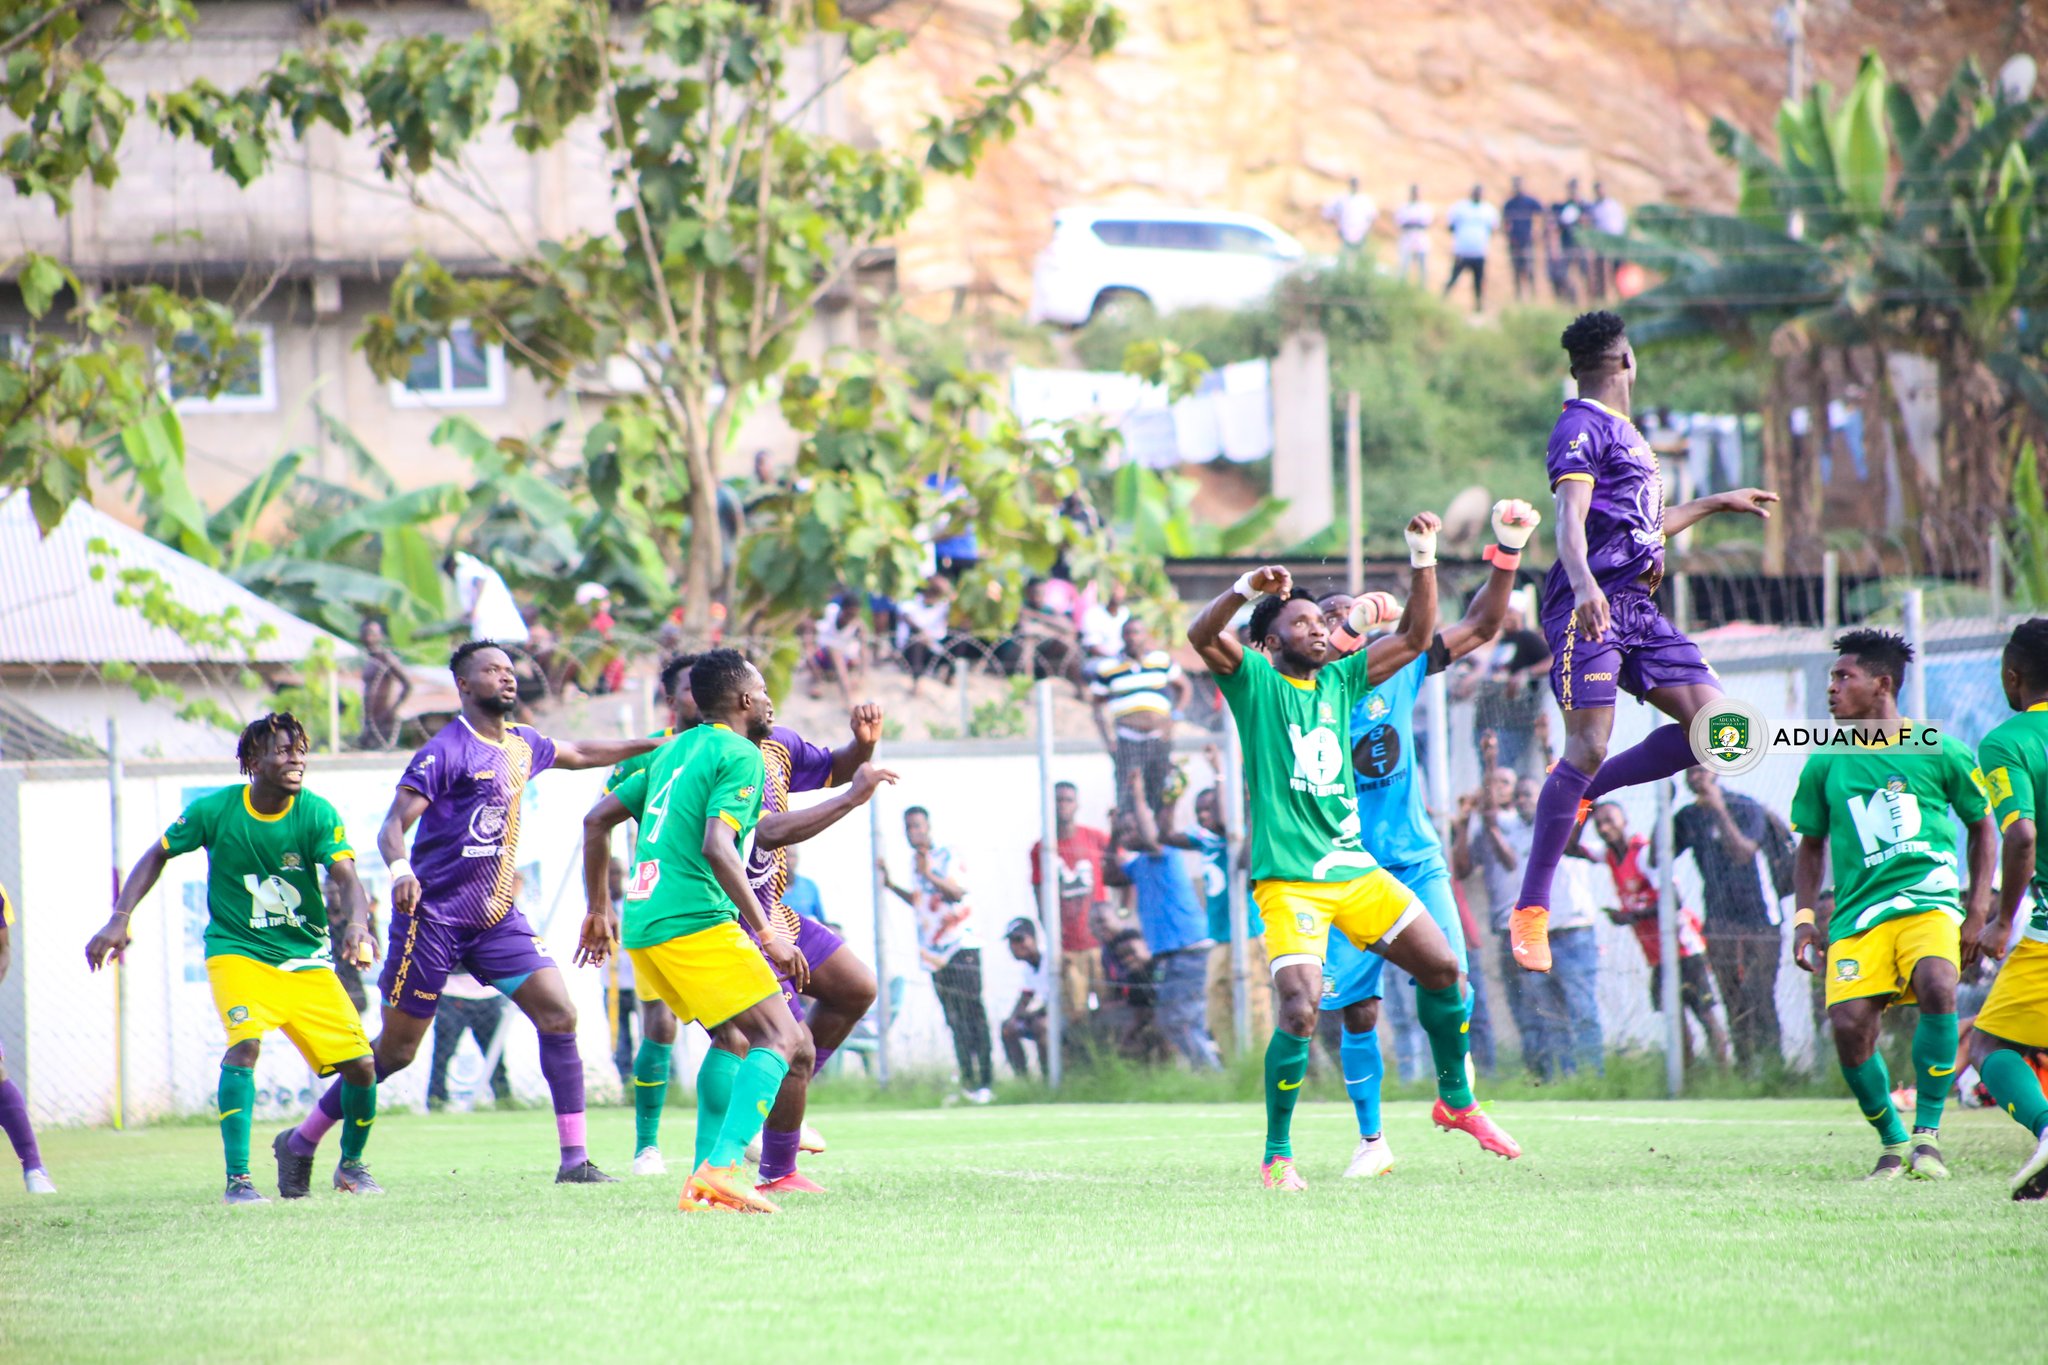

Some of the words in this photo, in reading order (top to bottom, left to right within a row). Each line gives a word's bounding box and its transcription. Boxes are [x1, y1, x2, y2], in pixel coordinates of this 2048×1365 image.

[1584, 672, 1612, 682] POKOO
[647, 765, 684, 844] 4
[1883, 790, 1903, 838] BET
[414, 989, 437, 1001] POKOO
